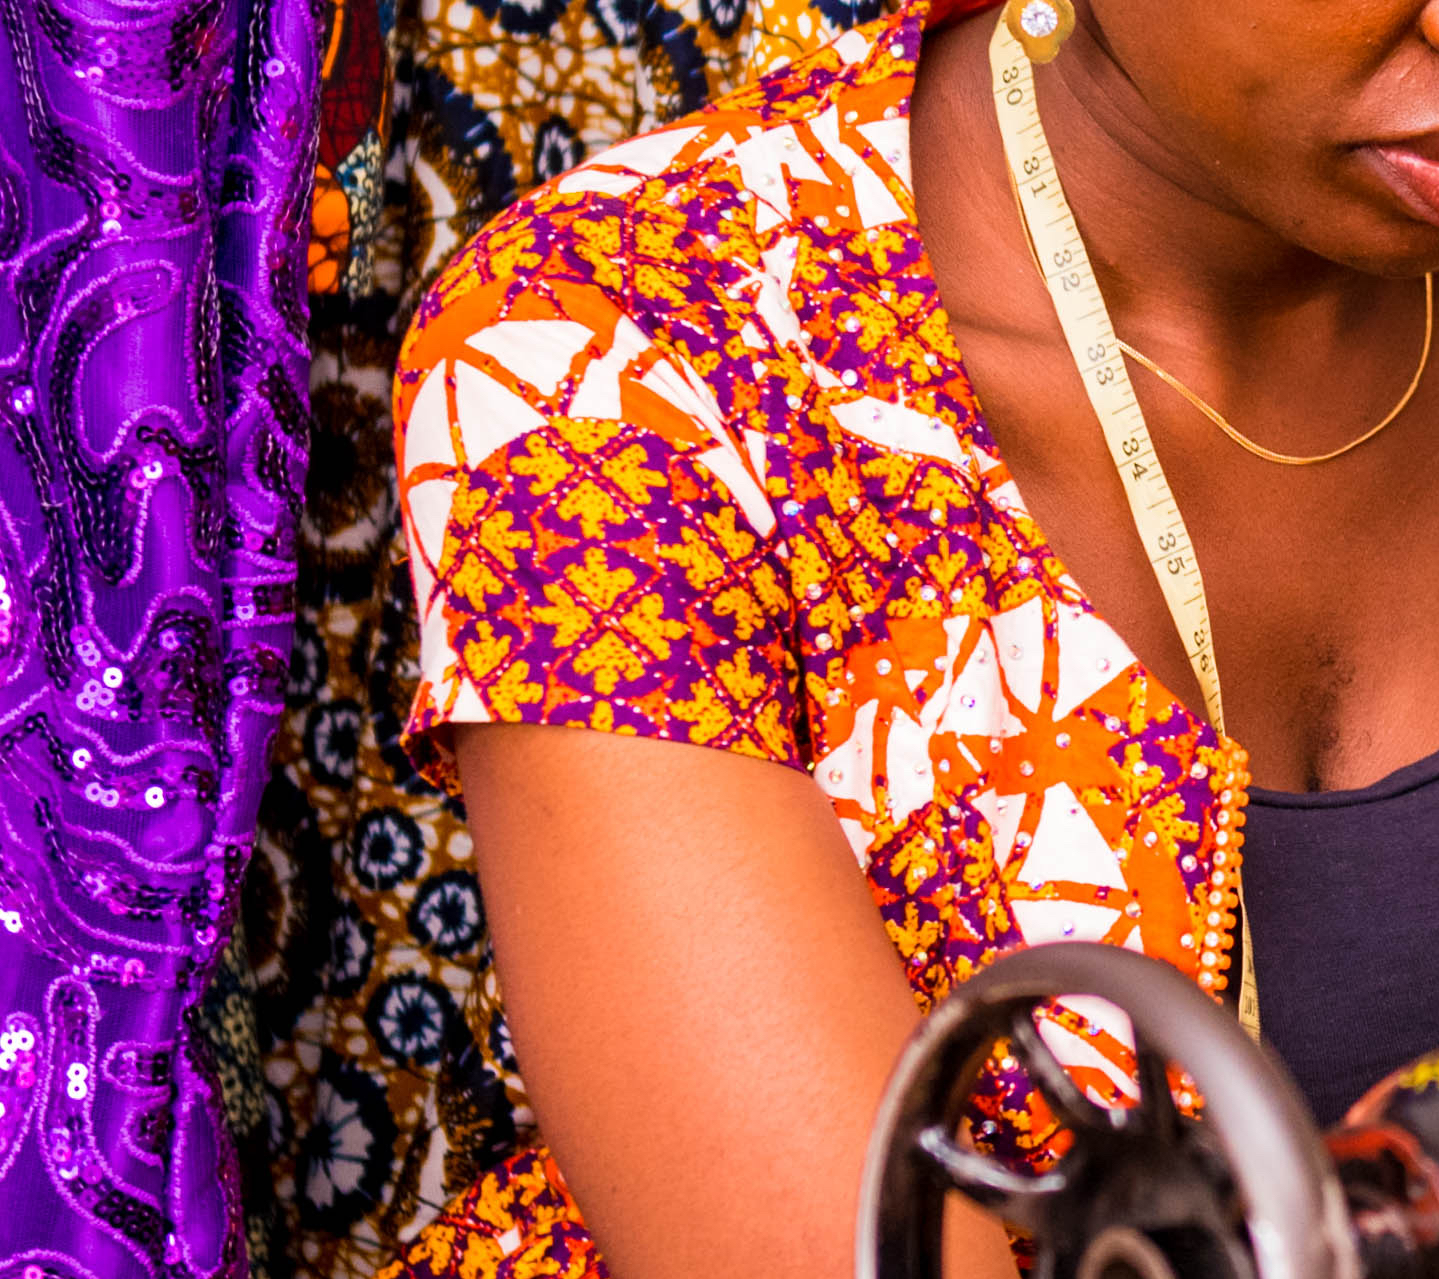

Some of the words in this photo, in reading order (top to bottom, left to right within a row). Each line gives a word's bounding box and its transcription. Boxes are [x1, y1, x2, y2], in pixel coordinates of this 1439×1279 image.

[1003, 66, 1023, 106] 30
[1023, 157, 1048, 197] 31
[1053, 249, 1080, 291] 32
[1087, 343, 1115, 386] 33
[1122, 437, 1148, 481] 34
[1158, 532, 1186, 575] 35
[1194, 629, 1209, 672] 36
